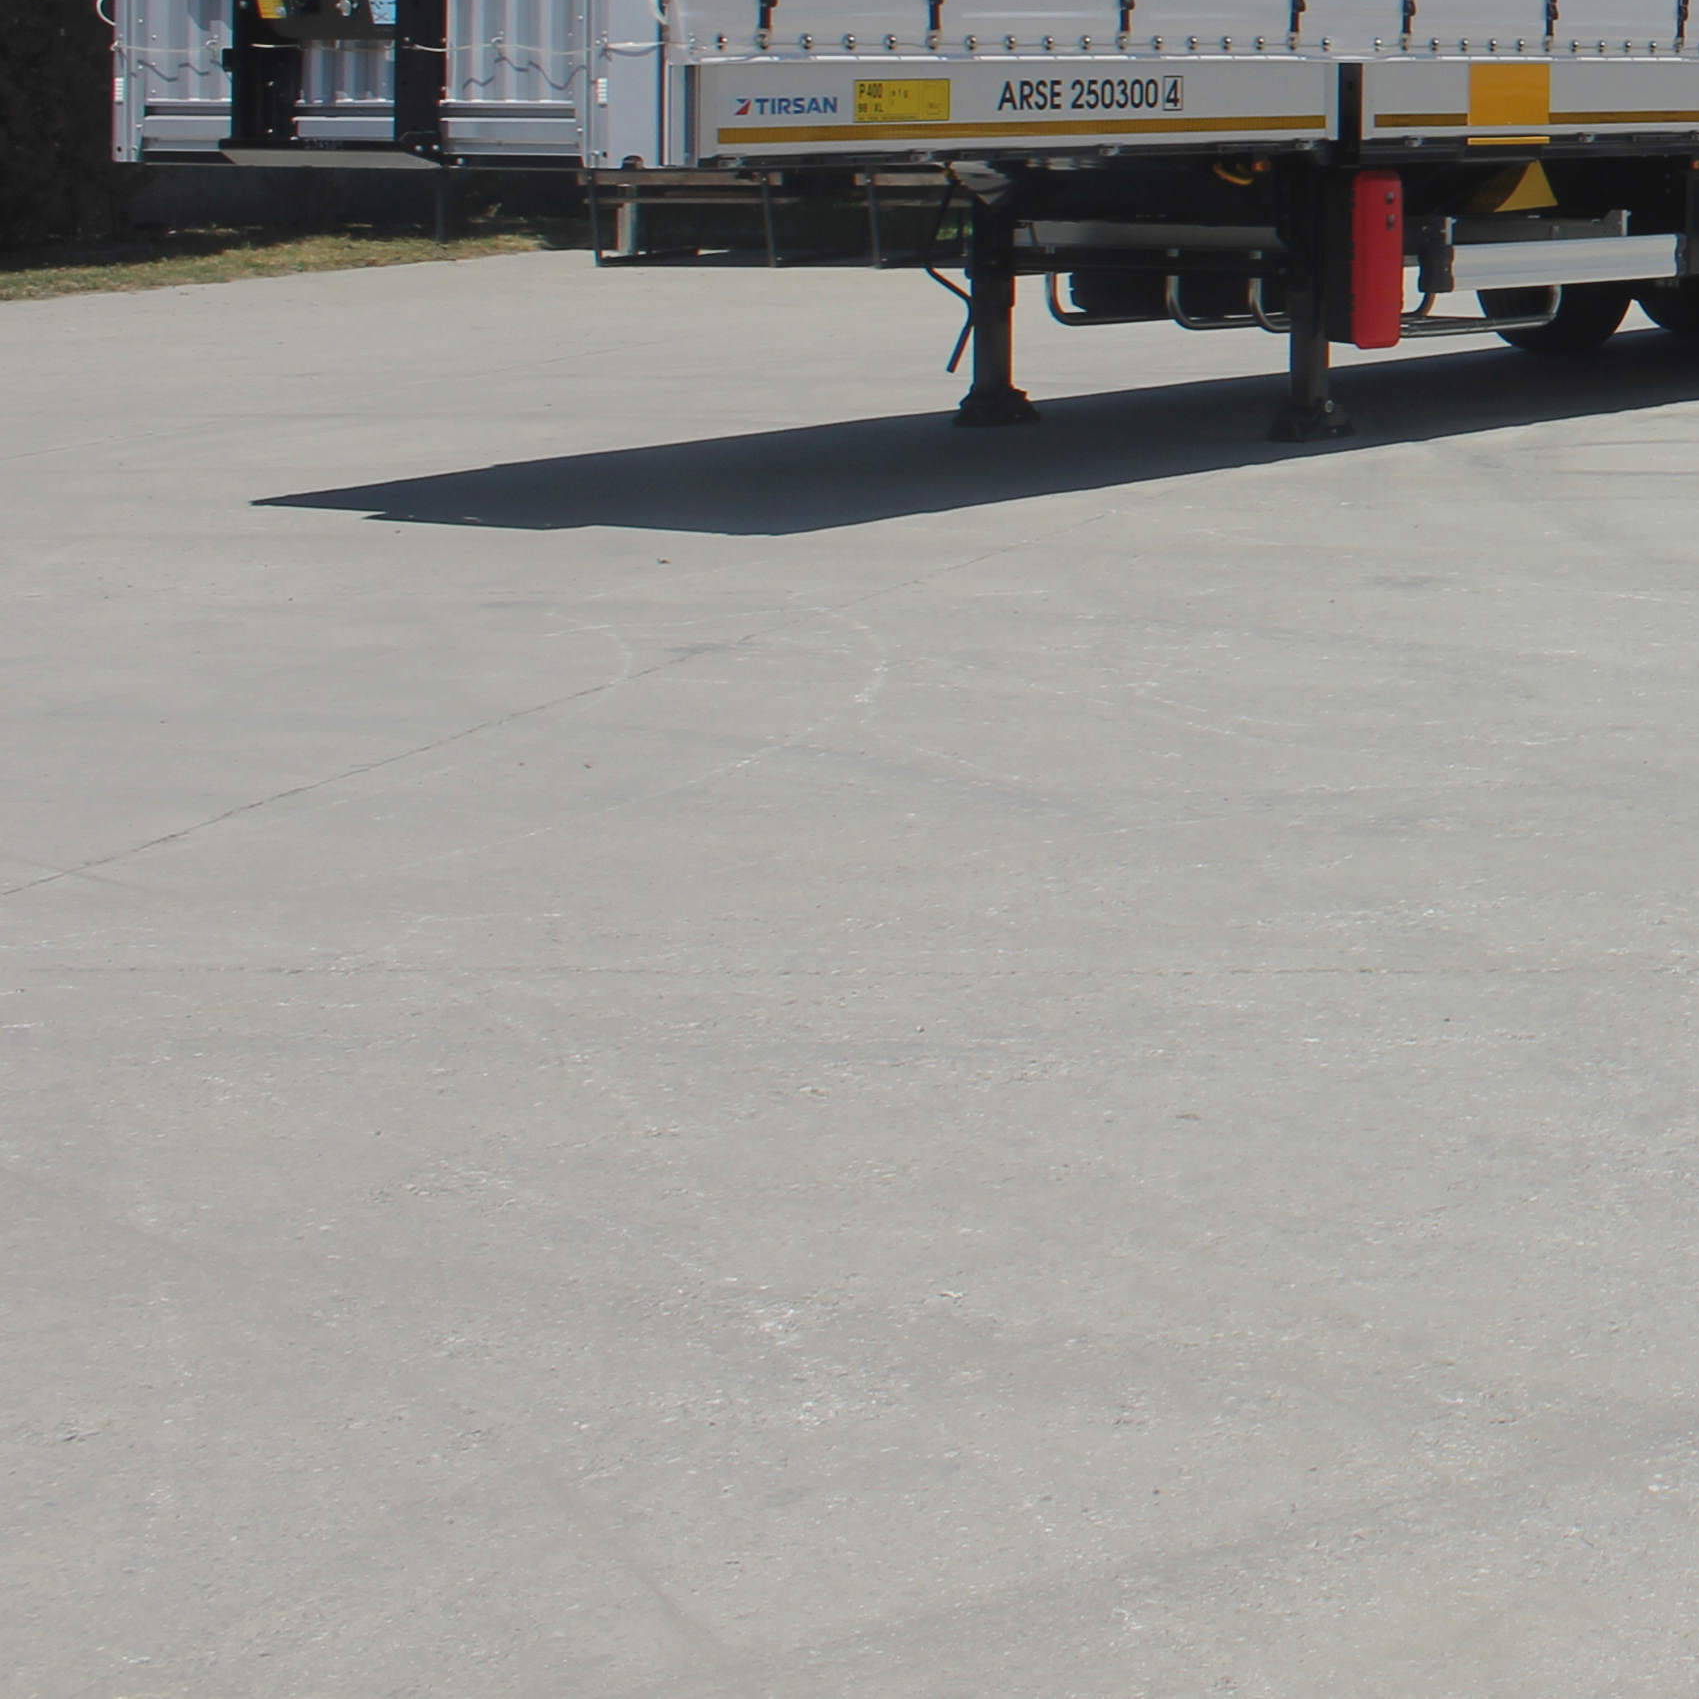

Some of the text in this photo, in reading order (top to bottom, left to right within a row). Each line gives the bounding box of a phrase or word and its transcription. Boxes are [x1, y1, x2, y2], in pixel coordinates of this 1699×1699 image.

[754, 97, 838, 115] TIRSAN
[997, 78, 1181, 111] ARSE 250300 4
